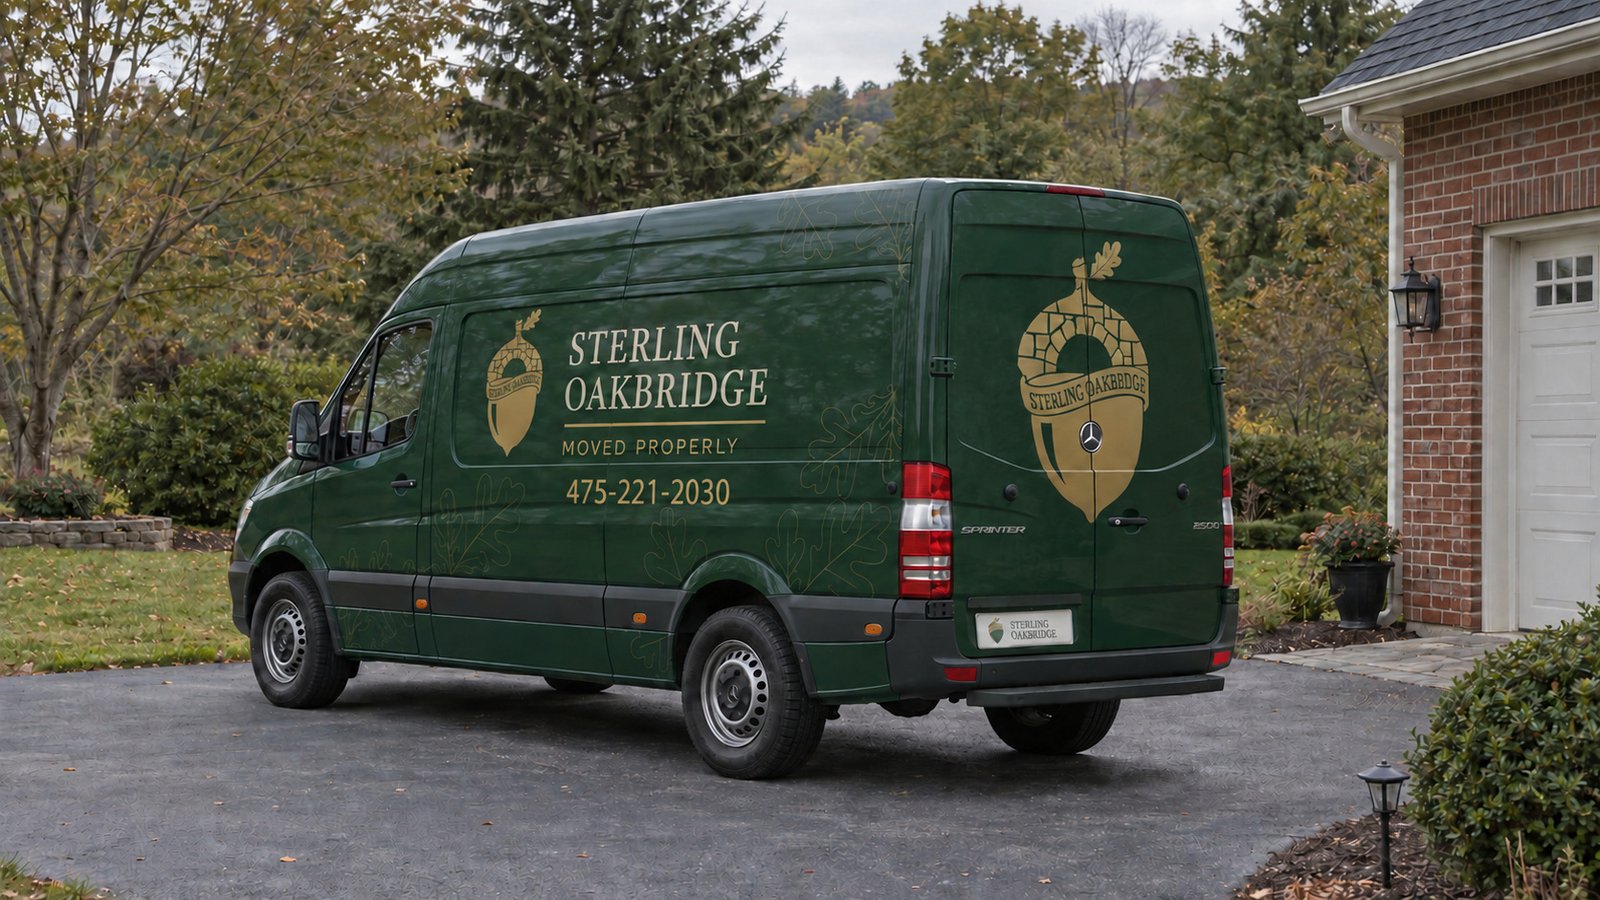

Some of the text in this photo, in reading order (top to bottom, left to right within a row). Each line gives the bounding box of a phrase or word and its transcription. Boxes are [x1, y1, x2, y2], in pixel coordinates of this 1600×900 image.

[569, 321, 740, 366] STERLING
[564, 368, 768, 412] OAKBRIDGE
[1029, 384, 1084, 410] STERLING
[562, 437, 738, 456] MOVED PROPERLY
[566, 478, 730, 505] 475-221-2030
[960, 525, 1026, 534] SPRINTER
[1193, 521, 1220, 530] 2500
[1010, 619, 1049, 629] STERLING
